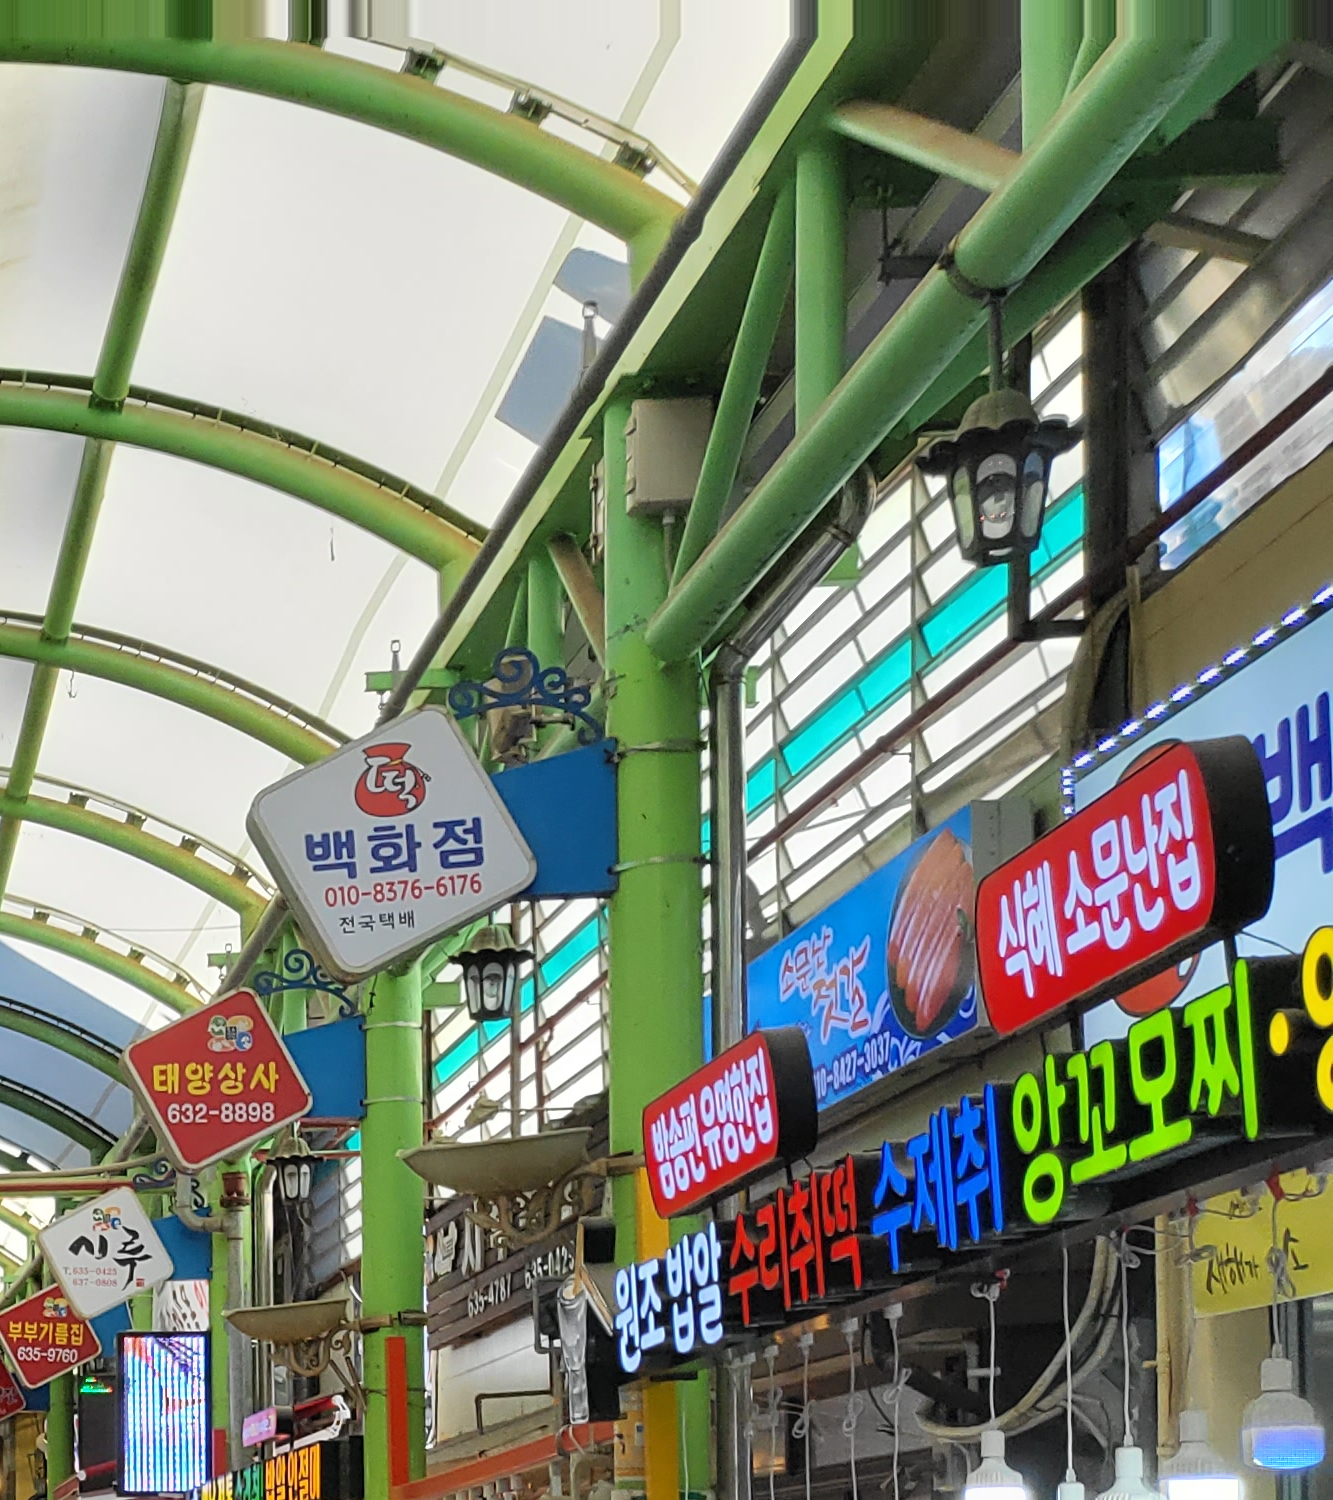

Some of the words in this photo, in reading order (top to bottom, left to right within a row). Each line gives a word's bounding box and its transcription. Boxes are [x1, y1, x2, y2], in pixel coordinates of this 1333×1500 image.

[304, 816, 485, 880] 백화점
[324, 872, 483, 908] 010-8376-6176
[997, 860, 1064, 997] 식혜
[1064, 768, 1202, 955] 소문난집
[339, 909, 416, 935] 전국택배
[152, 1060, 280, 1096] 태양상사
[166, 1101, 276, 1125] 632-8898
[651, 1093, 707, 1200] 밤송편
[699, 1046, 774, 1170] 유명한집
[614, 1257, 667, 1373] 원조
[666, 1220, 724, 1354] 밥알
[729, 1153, 863, 1328] 수리취떡
[872, 1084, 1003, 1275] 수제취
[68, 1226, 153, 1291] 시루
[8, 1320, 84, 1346] 부부기름집
[17, 1346, 78, 1364] 635-9760
